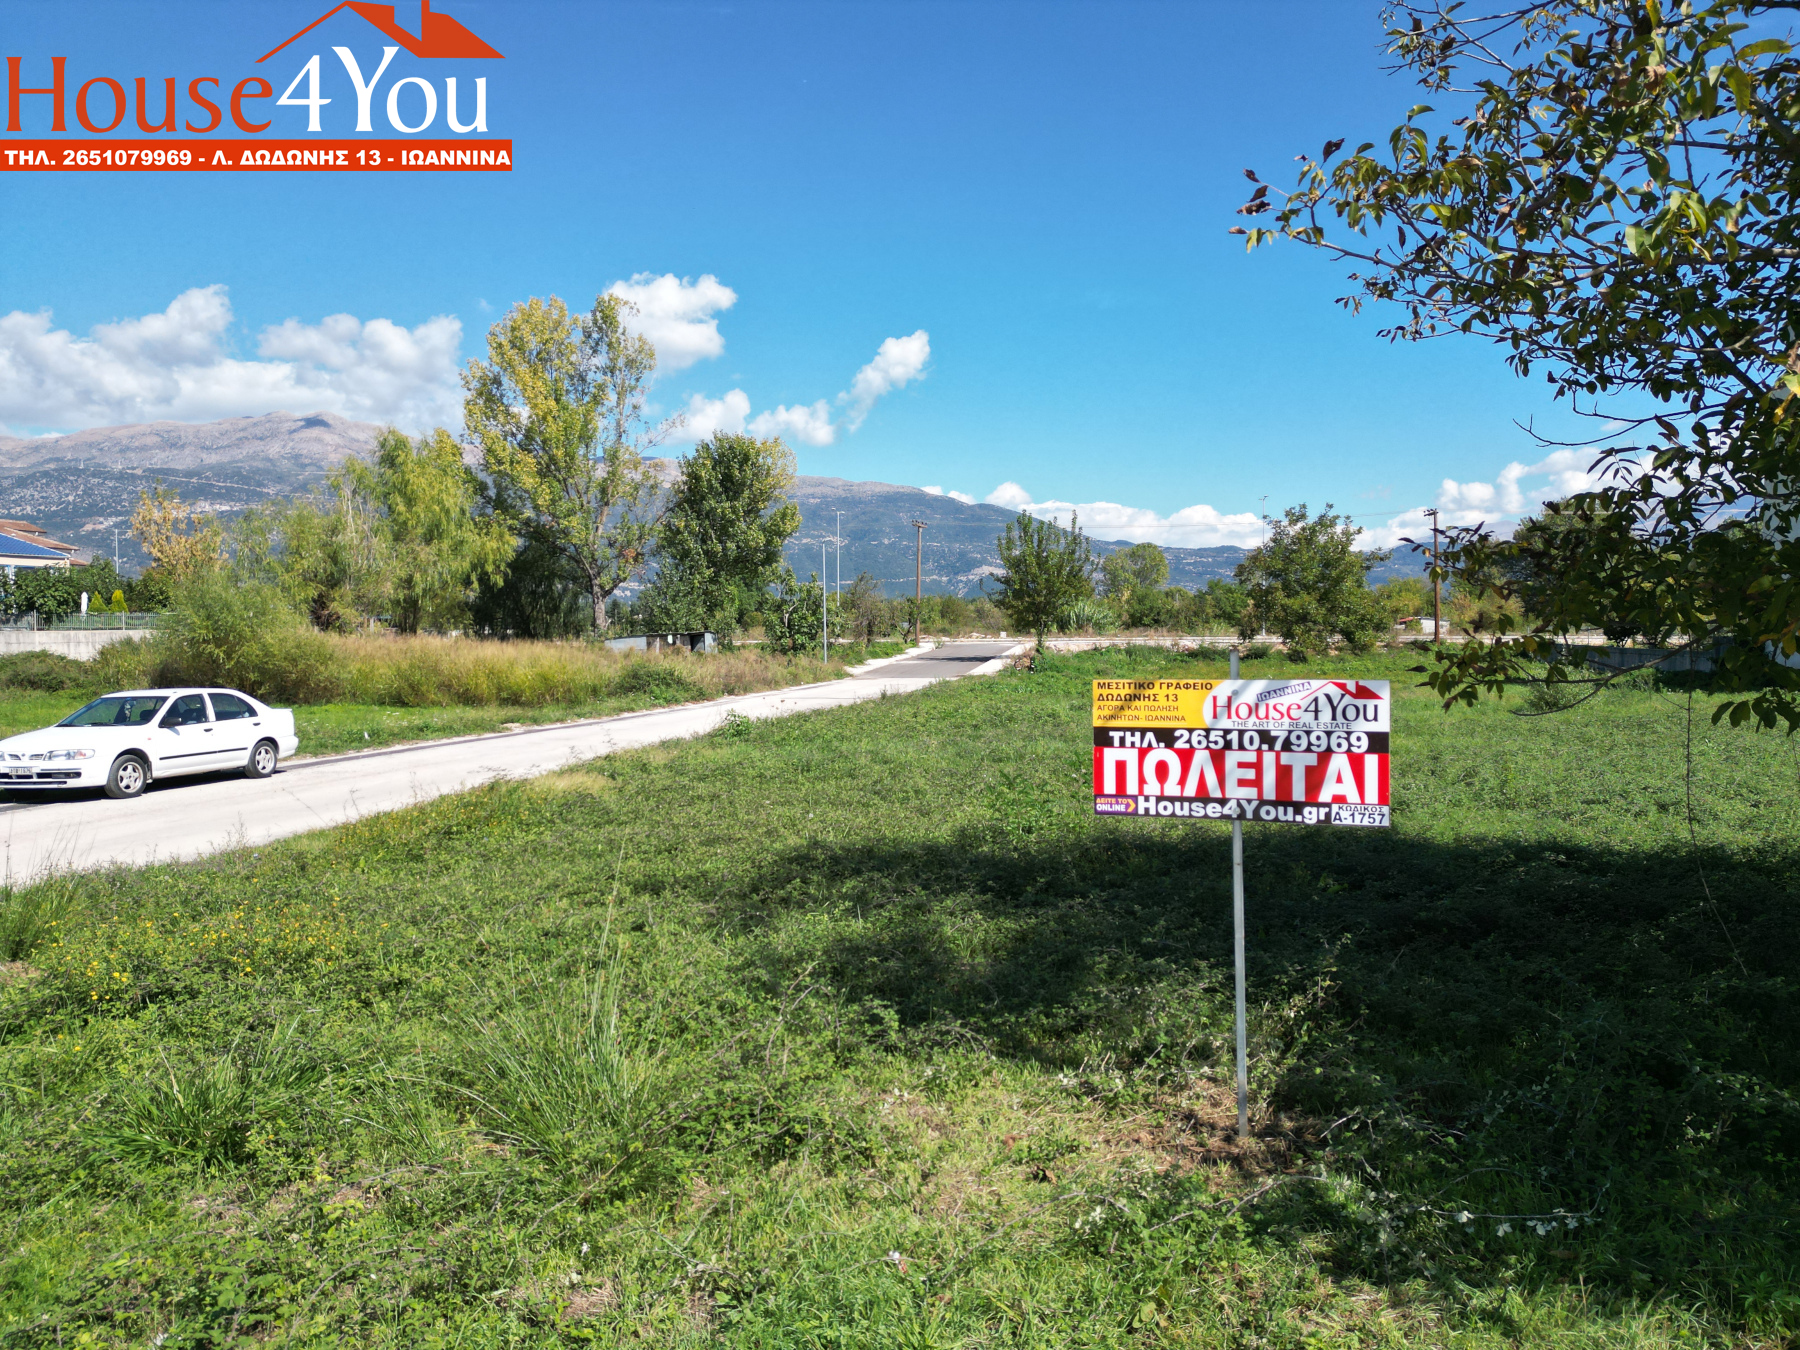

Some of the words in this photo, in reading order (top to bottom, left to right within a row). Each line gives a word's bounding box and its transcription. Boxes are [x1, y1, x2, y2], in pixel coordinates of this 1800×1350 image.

[1097, 682, 1155, 690] ΜΕΣΙΤΙΚΟ
[1159, 682, 1213, 690] ΓΡΑΦΕΙΟ
[1257, 682, 1311, 702] ΙΩΑΝΝΙΝΑ
[1097, 693, 1160, 702] ΔΩΔΩΝΗΣ
[1164, 693, 1179, 702] 13
[1212, 693, 1378, 722] House4You
[1097, 704, 1125, 712] ΑΓΟΡΑ
[1109, 731, 1165, 748] ΤΗΛ.
[1174, 729, 1369, 753] 26510.79969
[1103, 748, 1379, 805] ΠΩΛΕΙΤΑΙ
[1138, 796, 1329, 825] House4You.gr
[1338, 804, 1385, 813] ΚΩΔΙΚΟΣ
